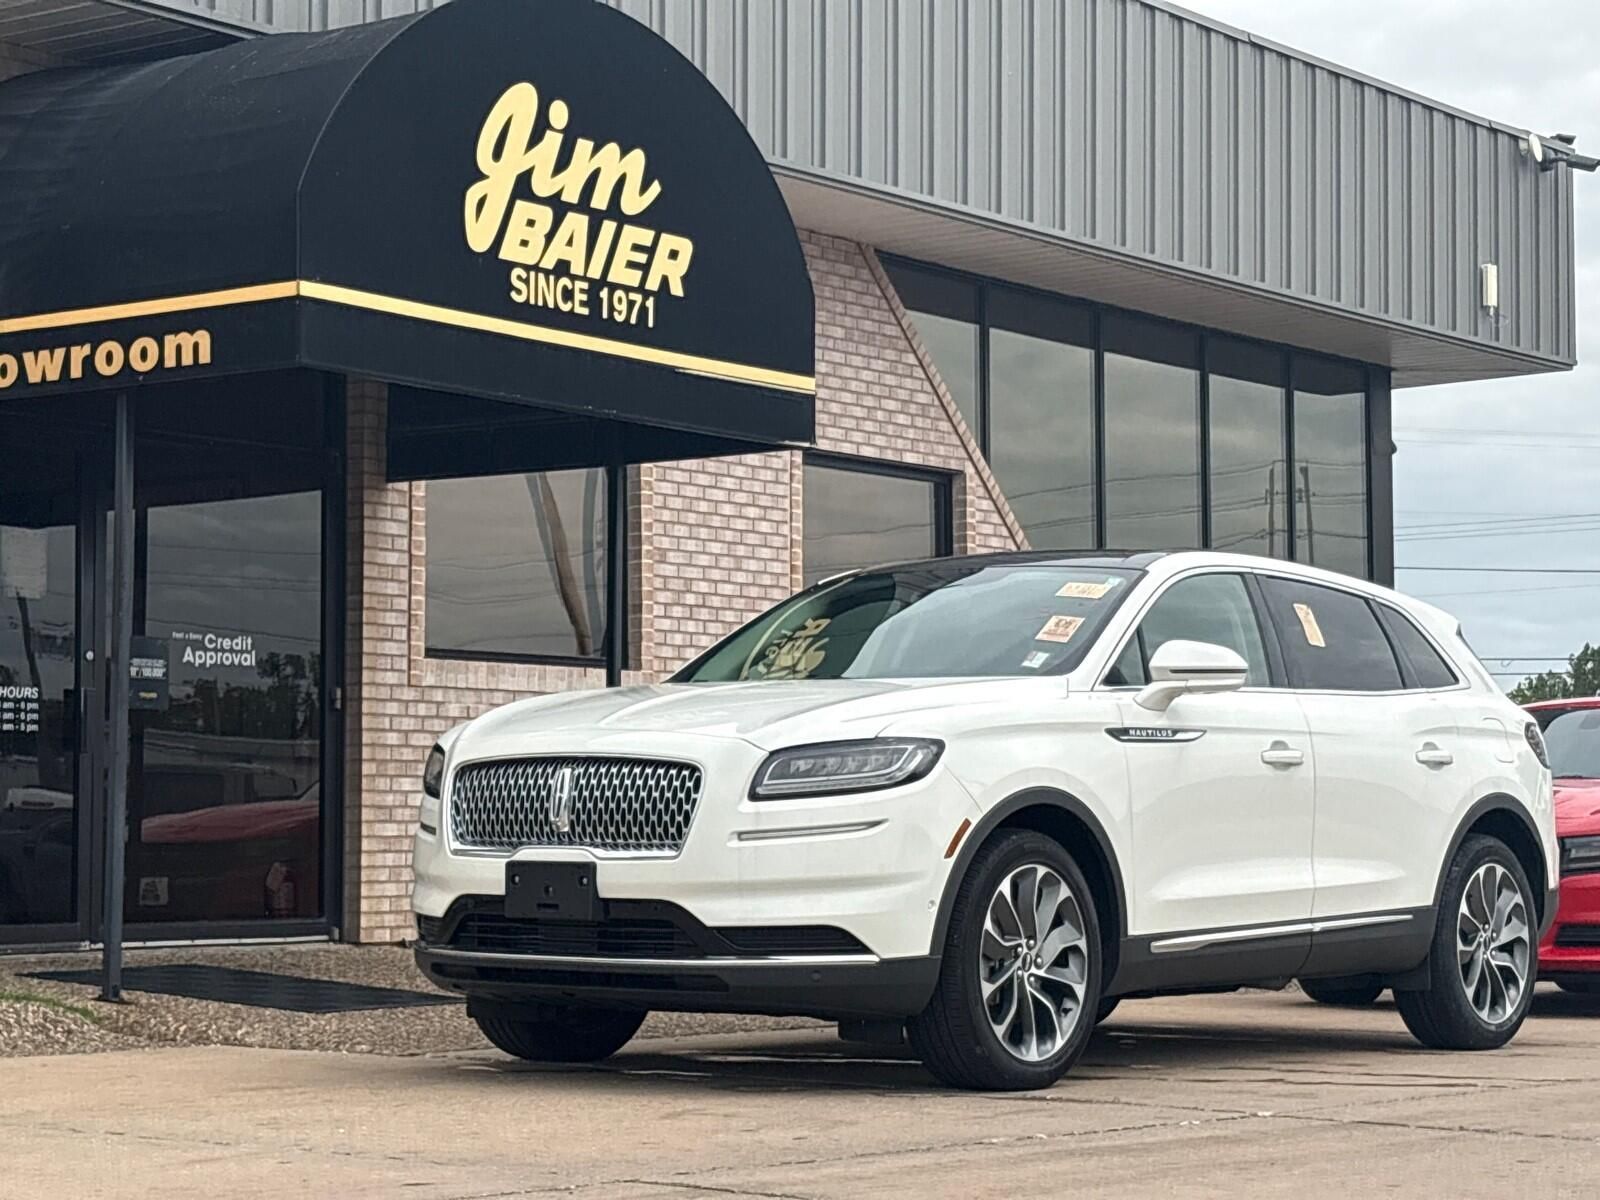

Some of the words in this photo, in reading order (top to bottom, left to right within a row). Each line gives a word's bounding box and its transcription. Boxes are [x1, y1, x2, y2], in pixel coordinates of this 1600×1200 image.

[464, 82, 662, 253] Jim
[498, 199, 694, 297] BAIER
[510, 267, 589, 316] SINCE
[599, 287, 654, 328] 1971
[0, 329, 211, 388] owroom
[182, 646, 256, 668] Approval
[204, 633, 252, 651] Credit
[0, 685, 39, 699] HOURS
[1129, 729, 1173, 737] NAUTILUS
